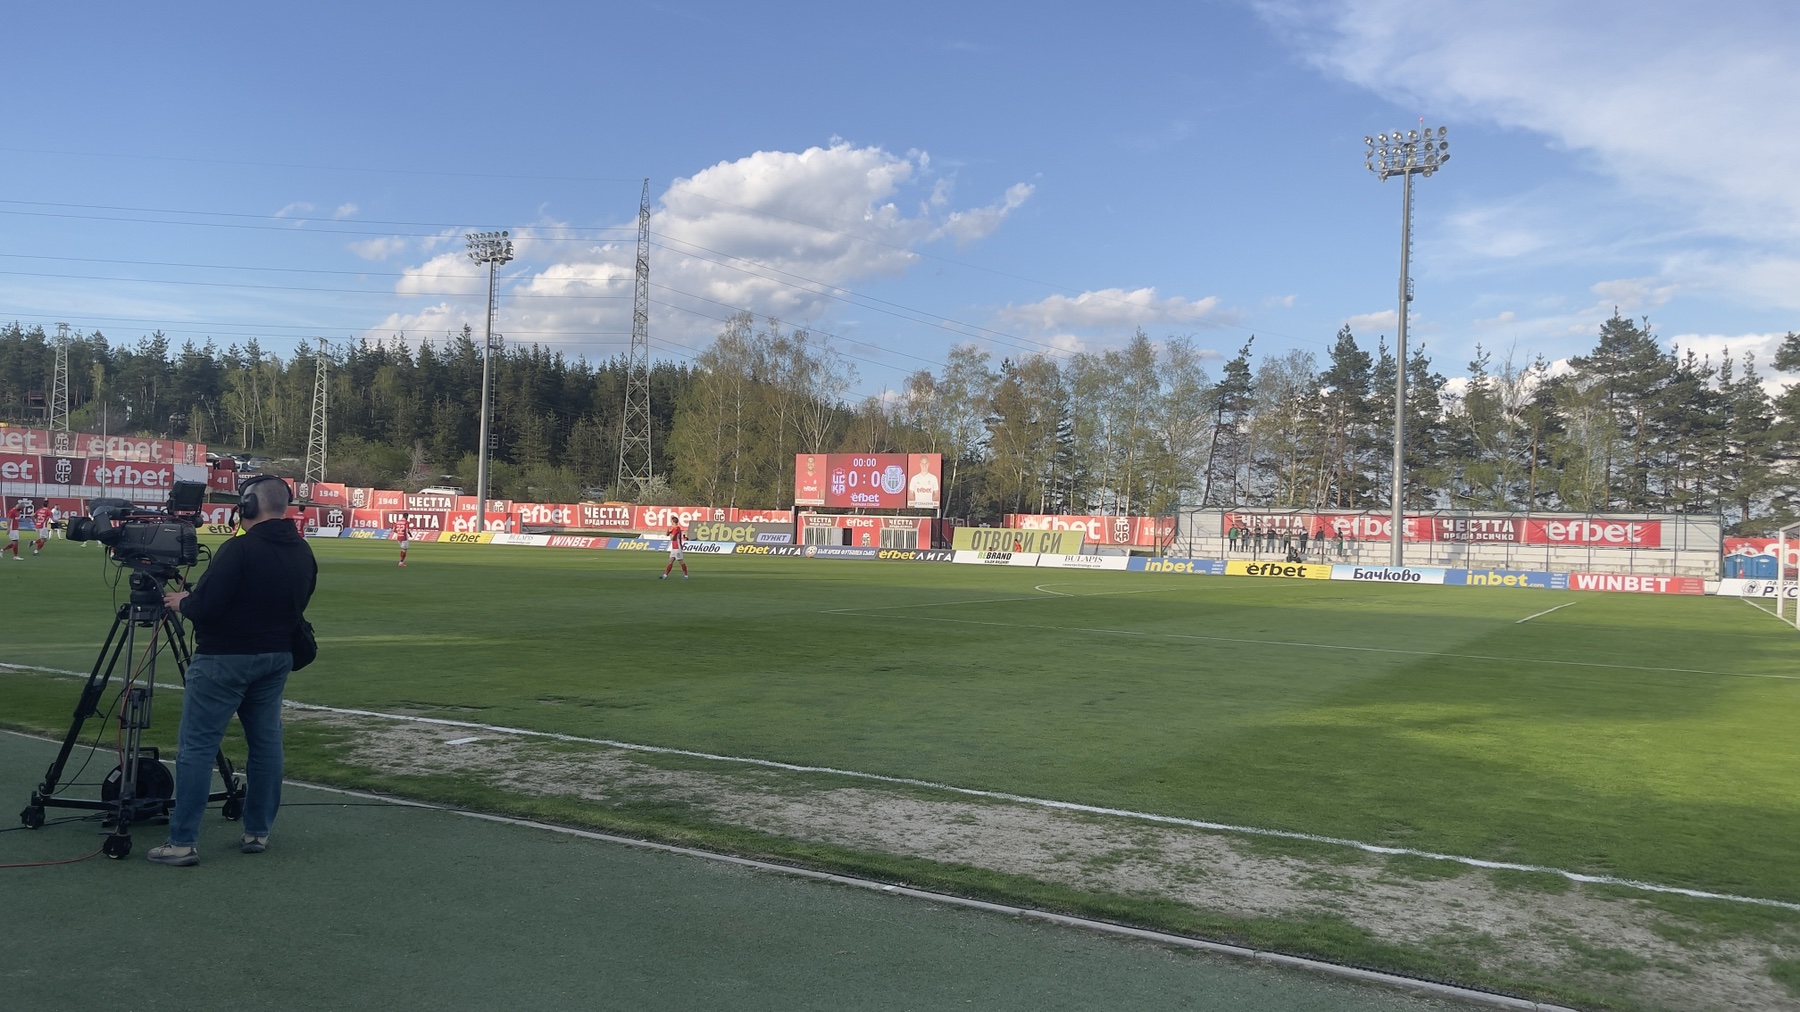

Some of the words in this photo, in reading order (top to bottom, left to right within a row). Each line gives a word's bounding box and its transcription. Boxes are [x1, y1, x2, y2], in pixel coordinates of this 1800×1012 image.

[853, 458, 877, 467] 00:00
[94, 465, 170, 486] efbet
[848, 471, 858, 488] 0
[871, 471, 880, 488] 0
[409, 496, 452, 508] ЧЕСТТА
[850, 493, 879, 503] efbet
[518, 504, 572, 524] efbet
[584, 507, 630, 520] ЧЕСТТА
[354, 520, 379, 528] 1948
[845, 517, 874, 528] efbet
[1241, 514, 1304, 528] ЧЕСТТА
[1442, 519, 1515, 533] ЧЕСТТА
[449, 532, 481, 543] efbet
[694, 522, 756, 543] efbet
[760, 533, 788, 541] ПУНКТ
[1476, 533, 1515, 541] ВСИЧКО
[1543, 520, 1642, 543] efbet
[551, 536, 596, 547] WINBET
[970, 529, 1035, 553] ОТВОРИ
[1039, 532, 1063, 554] СИ
[735, 544, 770, 555] efbet
[769, 548, 801, 556] ЛИГА
[878, 549, 915, 561] efbet
[915, 551, 952, 562] ЛИГА
[977, 551, 1013, 561] REBRAND
[1064, 555, 1104, 563] BULAPIS
[1245, 562, 1307, 577] efbet
[1353, 567, 1422, 582] Бачково
[1577, 574, 1671, 593] WINBET
